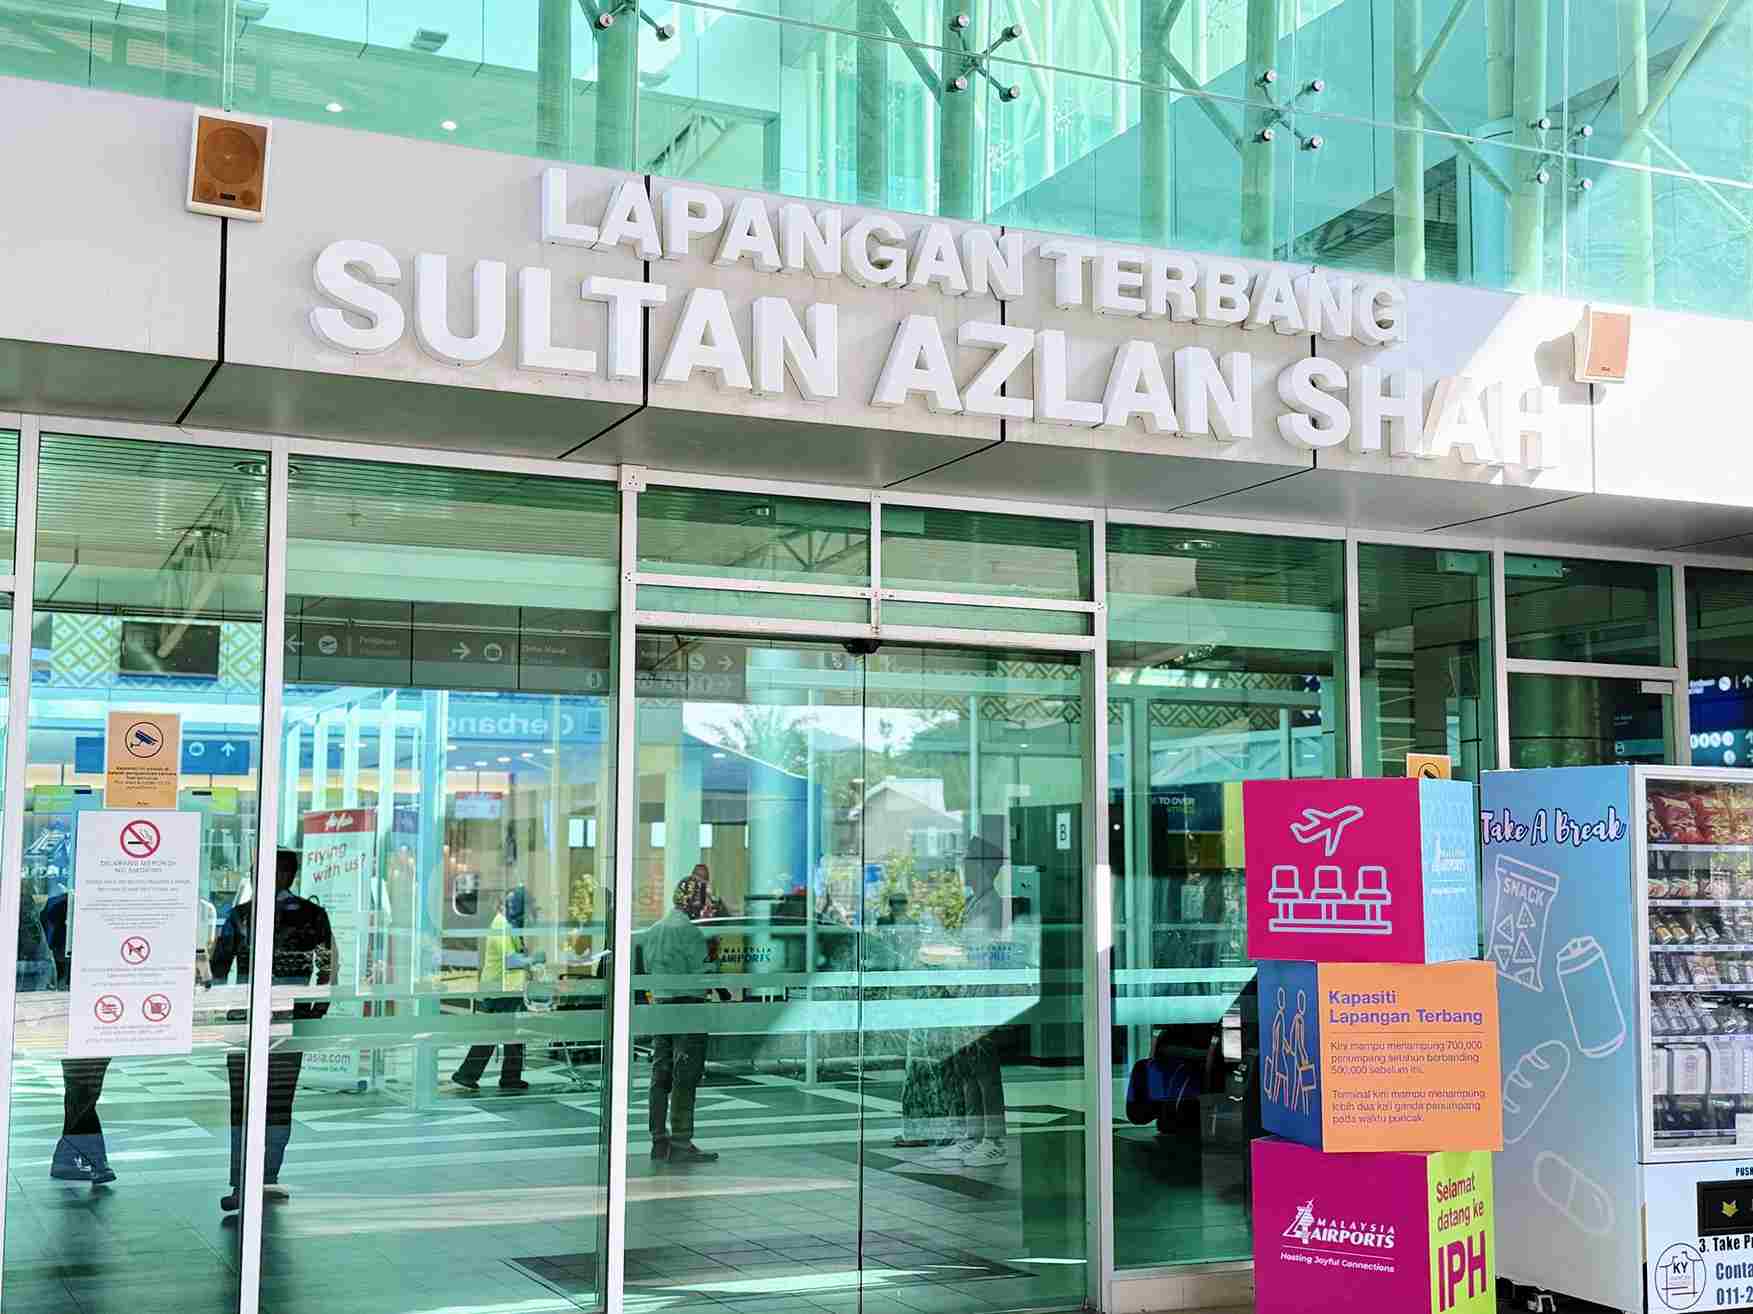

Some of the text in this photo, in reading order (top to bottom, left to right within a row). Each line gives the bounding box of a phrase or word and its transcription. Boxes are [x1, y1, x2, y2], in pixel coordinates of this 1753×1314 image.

[541, 167, 1407, 346] LAPANGAN TERBANG
[309, 239, 1561, 469] SULTAN AZLAN SHAH
[1481, 805, 1627, 848] Take A Break
[307, 842, 347, 866] Flying
[313, 853, 366, 885] with us?
[1328, 990, 1396, 1006] Kapasiti
[1329, 1008, 1483, 1025] Lapangan Terbang
[1447, 1040, 1482, 1050] 700,000
[1436, 1172, 1476, 1203] Selamat
[1316, 1218, 1395, 1235] MALAYSIA
[1438, 1199, 1485, 1232] datang ke
[1310, 1228, 1396, 1249] AIRPORTS
[1699, 1238, 1710, 1253] 3.
[1713, 1237, 1740, 1252] Take
[1280, 1252, 1395, 1273] Hosting Joyful Connections
[1438, 1231, 1487, 1313] IPH
[1673, 1262, 1688, 1275] KY
